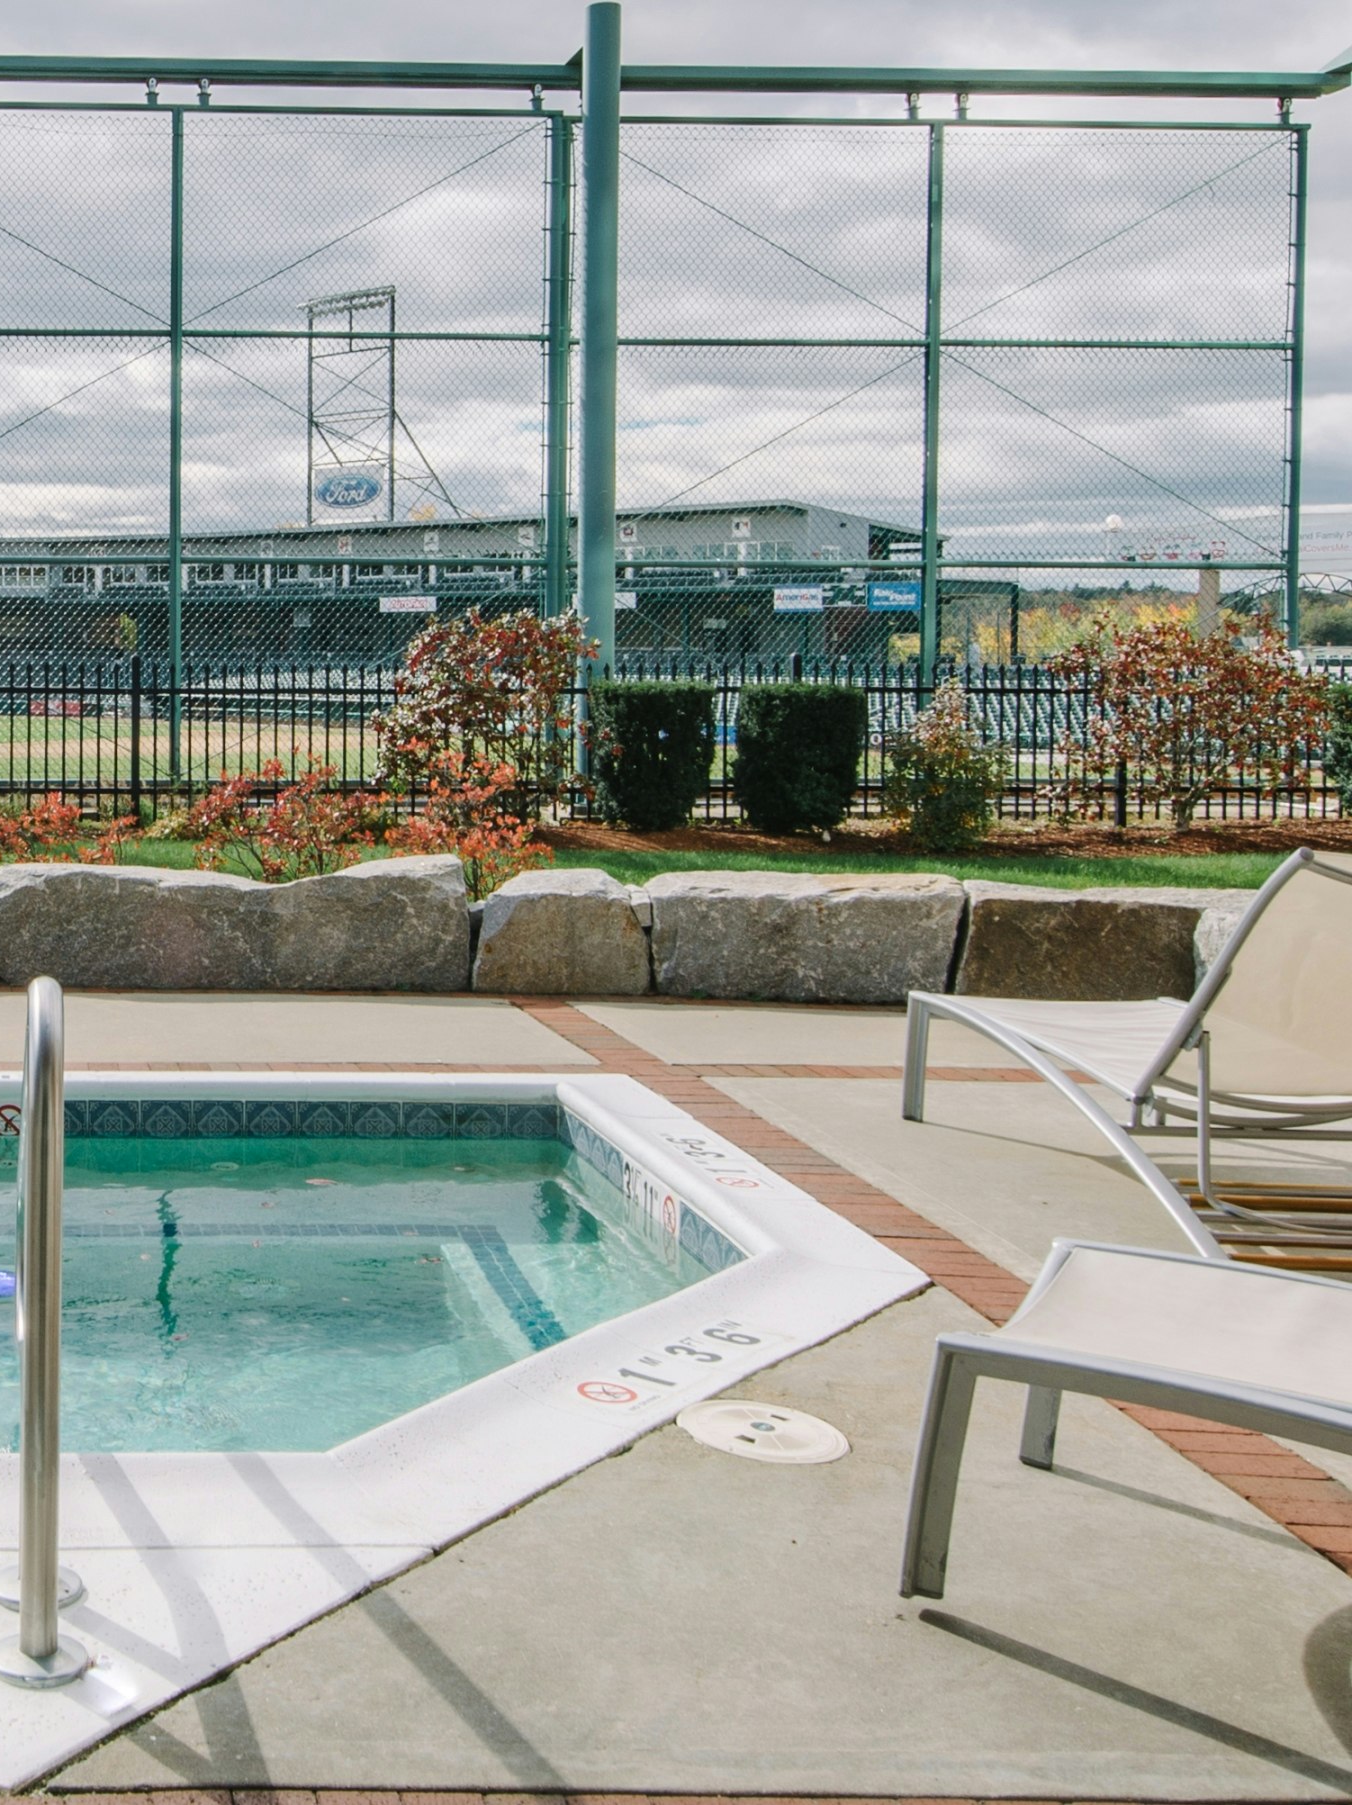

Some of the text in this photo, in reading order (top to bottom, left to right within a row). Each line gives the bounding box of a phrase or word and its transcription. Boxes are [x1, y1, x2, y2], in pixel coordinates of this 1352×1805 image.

[325, 480, 368, 502] Ford
[618, 1368, 677, 1386] 1
[664, 1345, 723, 1363] 3
[703, 1328, 761, 1345] 6
